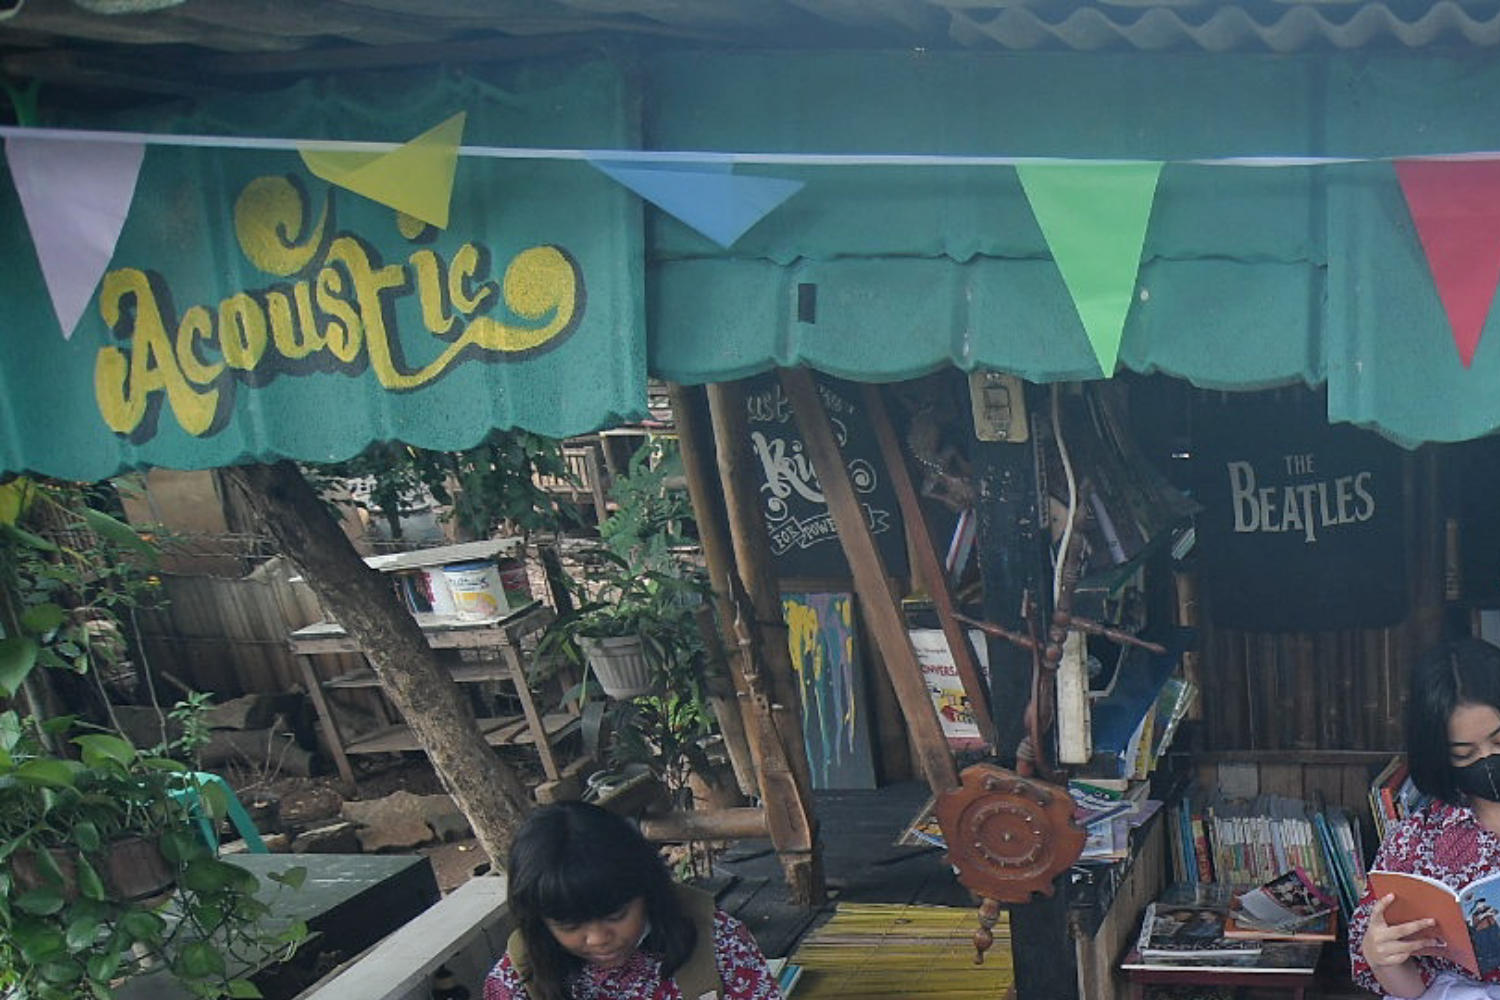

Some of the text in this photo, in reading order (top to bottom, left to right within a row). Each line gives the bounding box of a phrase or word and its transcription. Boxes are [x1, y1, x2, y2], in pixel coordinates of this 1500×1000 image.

[96, 176, 576, 436] Acoustic
[1284, 453, 1316, 475] THE
[1227, 460, 1376, 543] BEATLES
[802, 518, 838, 541] POWE
